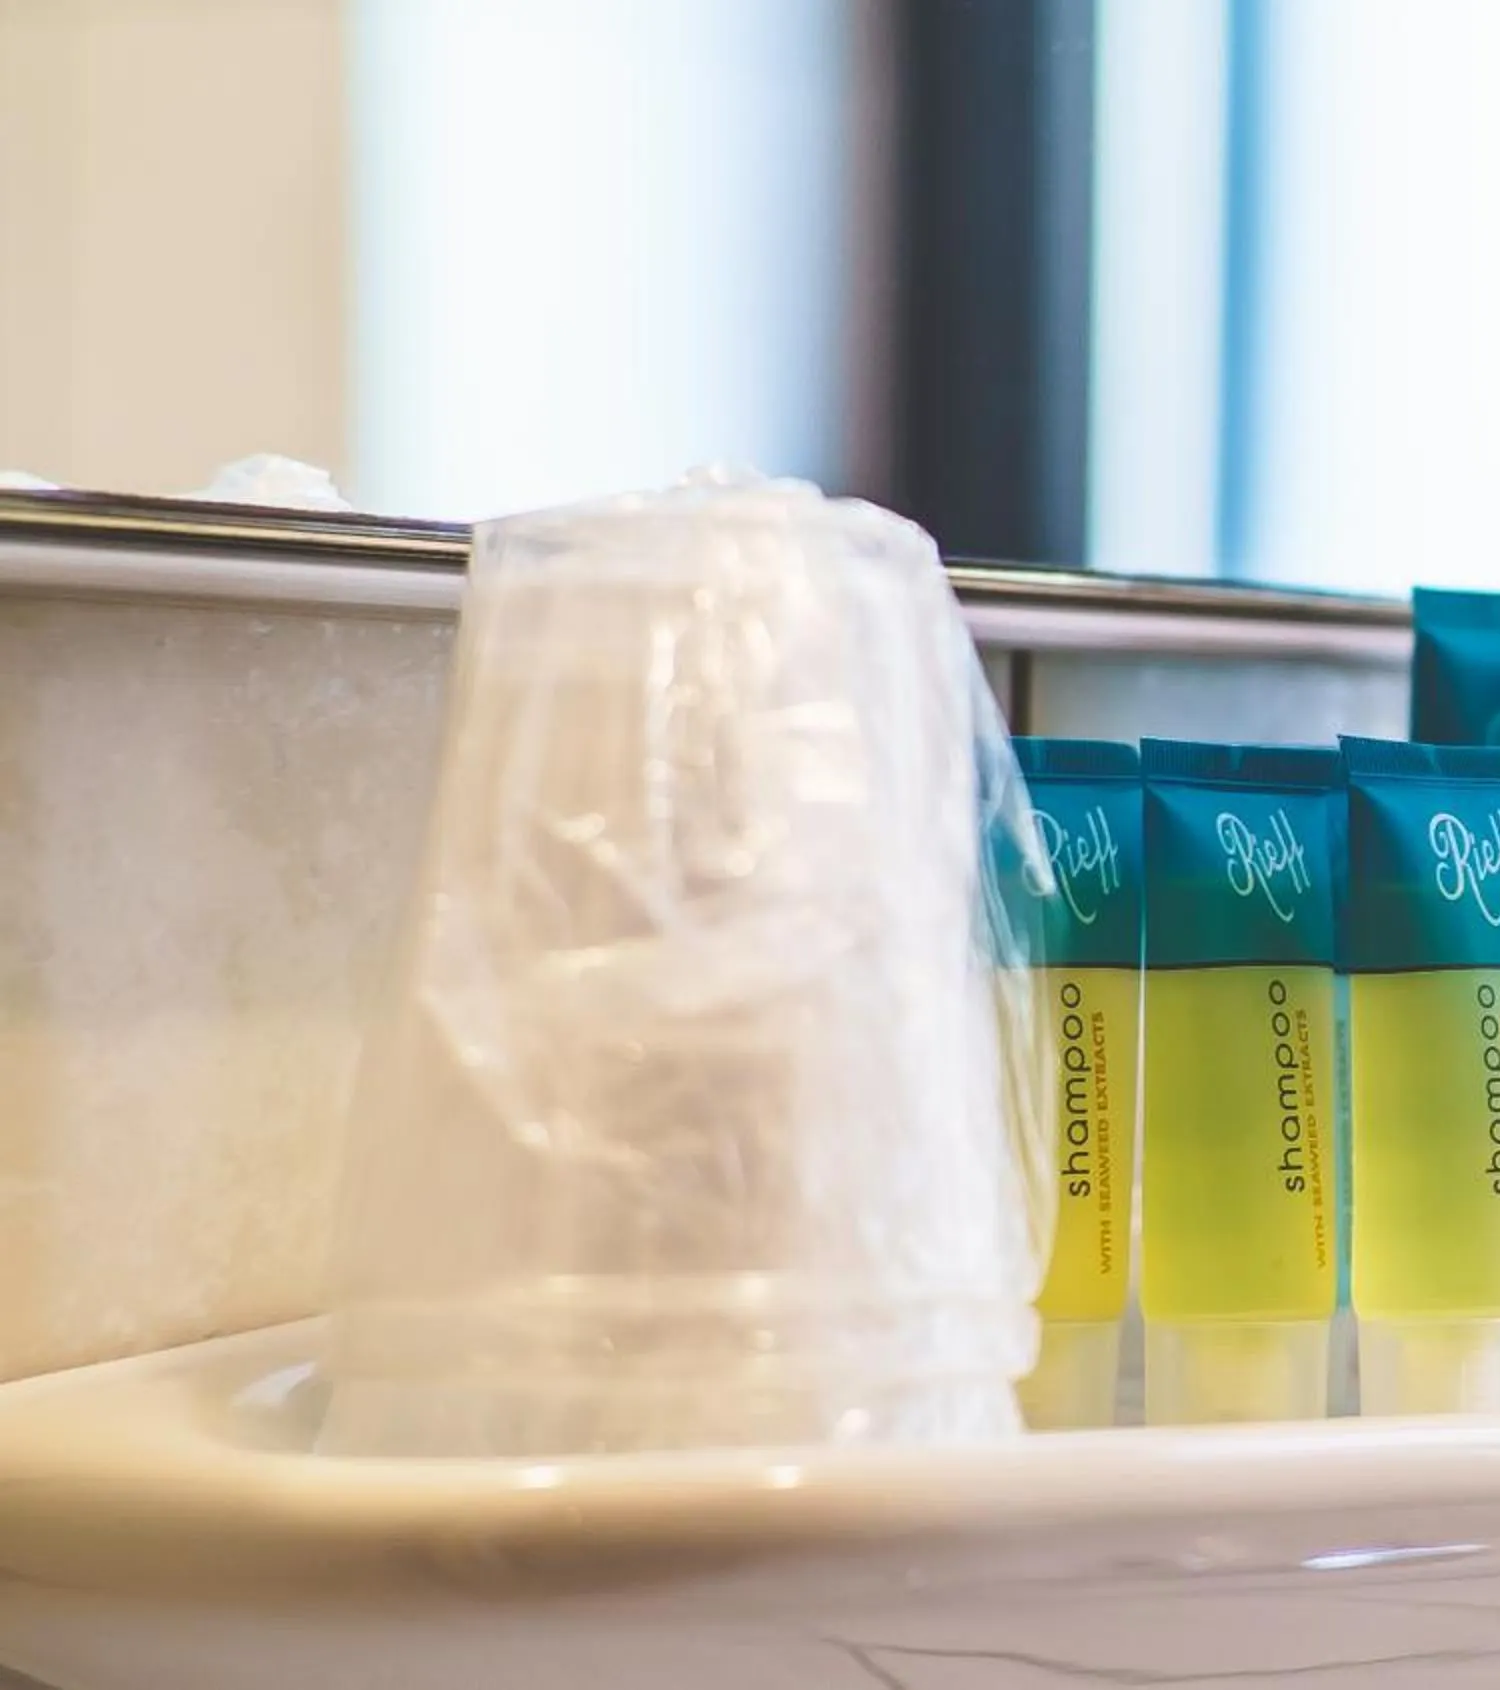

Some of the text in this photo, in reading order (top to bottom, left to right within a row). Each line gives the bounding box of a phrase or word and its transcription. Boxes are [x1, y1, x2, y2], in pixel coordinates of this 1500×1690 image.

[1216, 808, 1311, 923] Rieff
[1061, 983, 1091, 1197] shampoo
[1091, 1011, 1112, 1274] WITH SEAWEED EXTRACTS
[1268, 979, 1305, 1192] shampoo
[1297, 1010, 1327, 1269] WITH SEAWEED EXTRACTS
